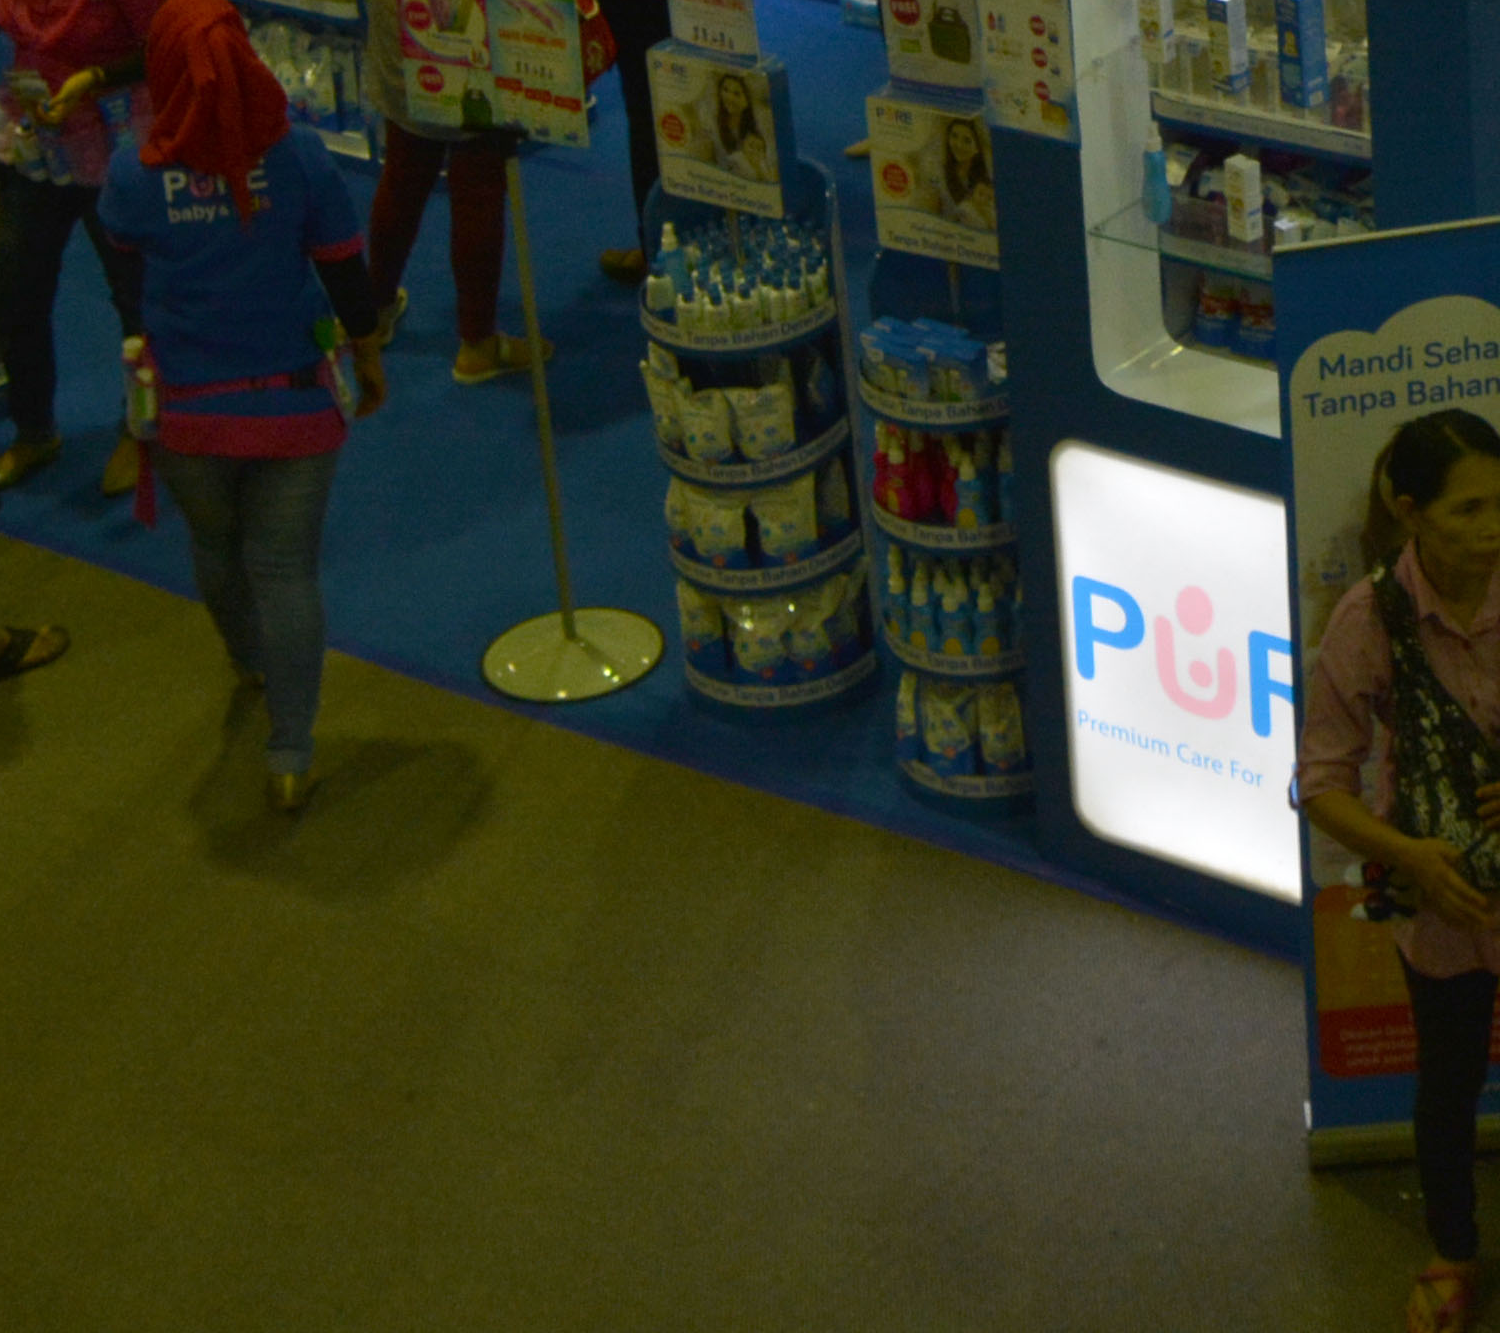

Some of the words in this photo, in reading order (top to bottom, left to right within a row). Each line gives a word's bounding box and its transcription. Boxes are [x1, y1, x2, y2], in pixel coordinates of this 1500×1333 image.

[1320, 345, 1413, 381] Mandi
[1304, 386, 1396, 419] Tanpa
[1077, 709, 1170, 759] Premium
[1178, 743, 1224, 776] Care
[1230, 759, 1265, 789] For
